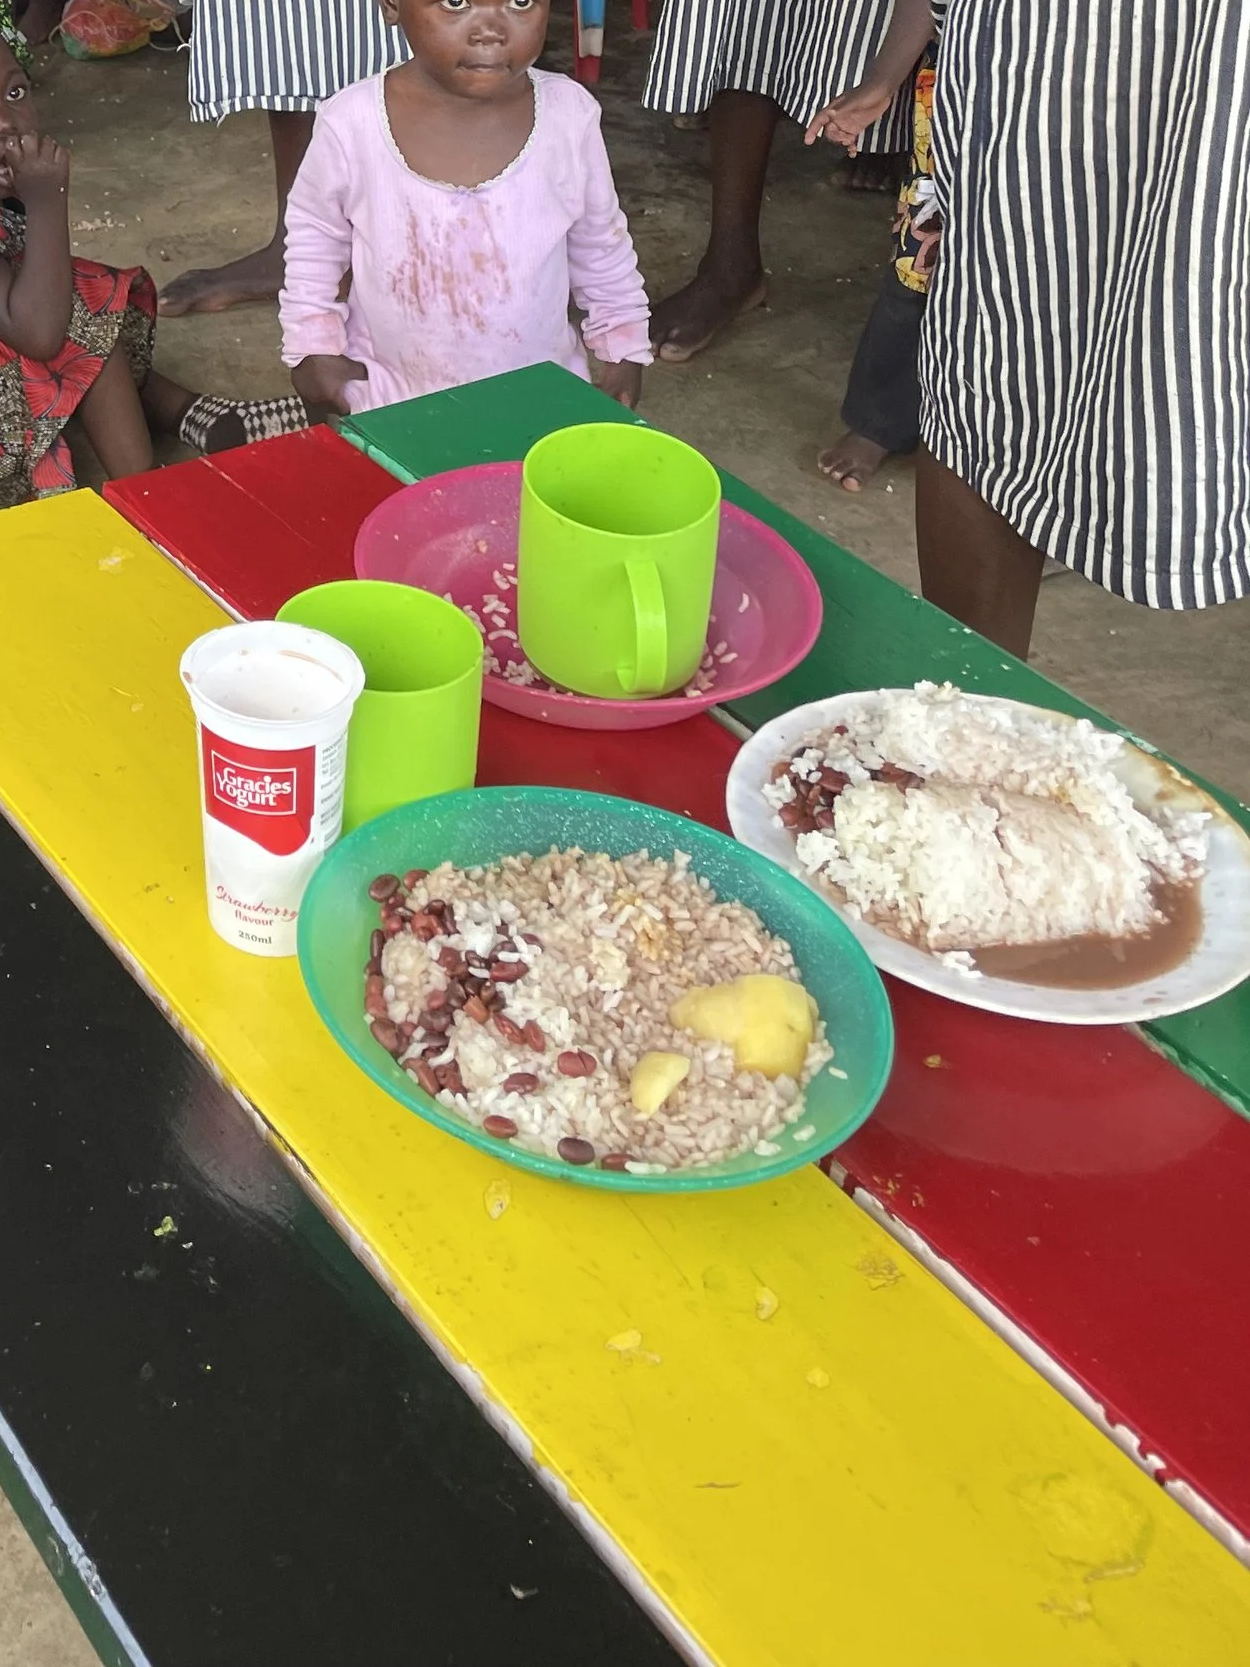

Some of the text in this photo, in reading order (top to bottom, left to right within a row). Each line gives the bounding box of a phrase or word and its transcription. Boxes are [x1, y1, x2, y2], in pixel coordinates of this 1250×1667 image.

[216, 771, 277, 808] Yogurt
[223, 767, 292, 794] Gracies
[216, 885, 298, 922] Strawberry
[235, 909, 274, 926] flavour
[238, 930, 272, 944] 250ml
